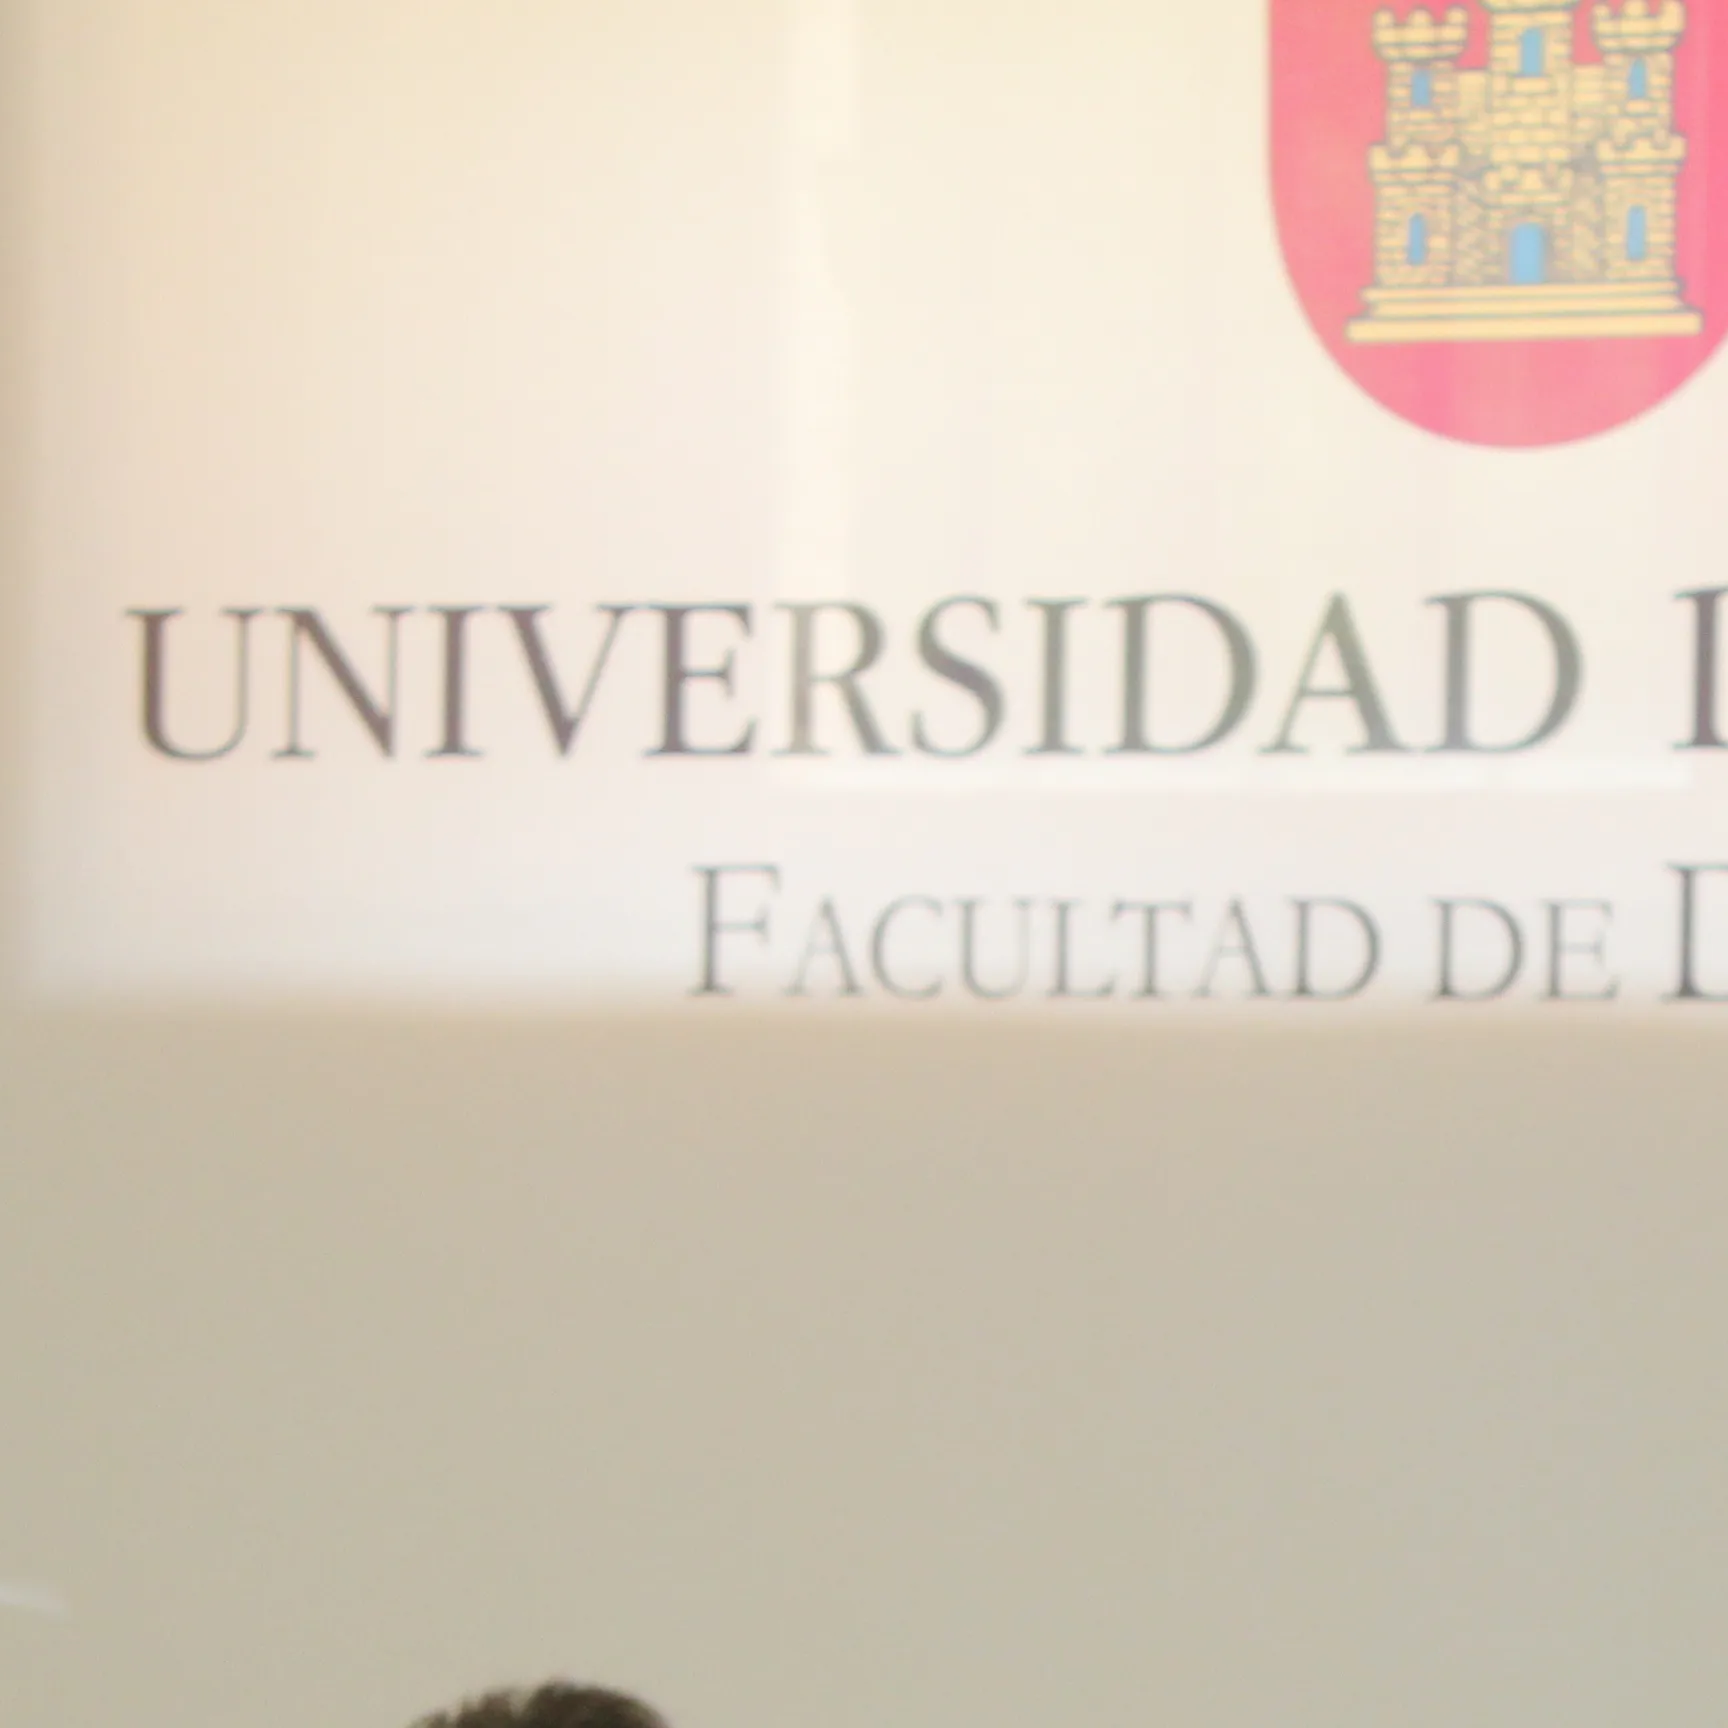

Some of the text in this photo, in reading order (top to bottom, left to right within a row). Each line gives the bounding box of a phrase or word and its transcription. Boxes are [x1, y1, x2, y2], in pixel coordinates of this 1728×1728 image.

[124, 589, 1585, 762] UNIVERSIDAD
[689, 863, 1384, 1001] FACULTAD
[1430, 899, 1622, 1003] DE
